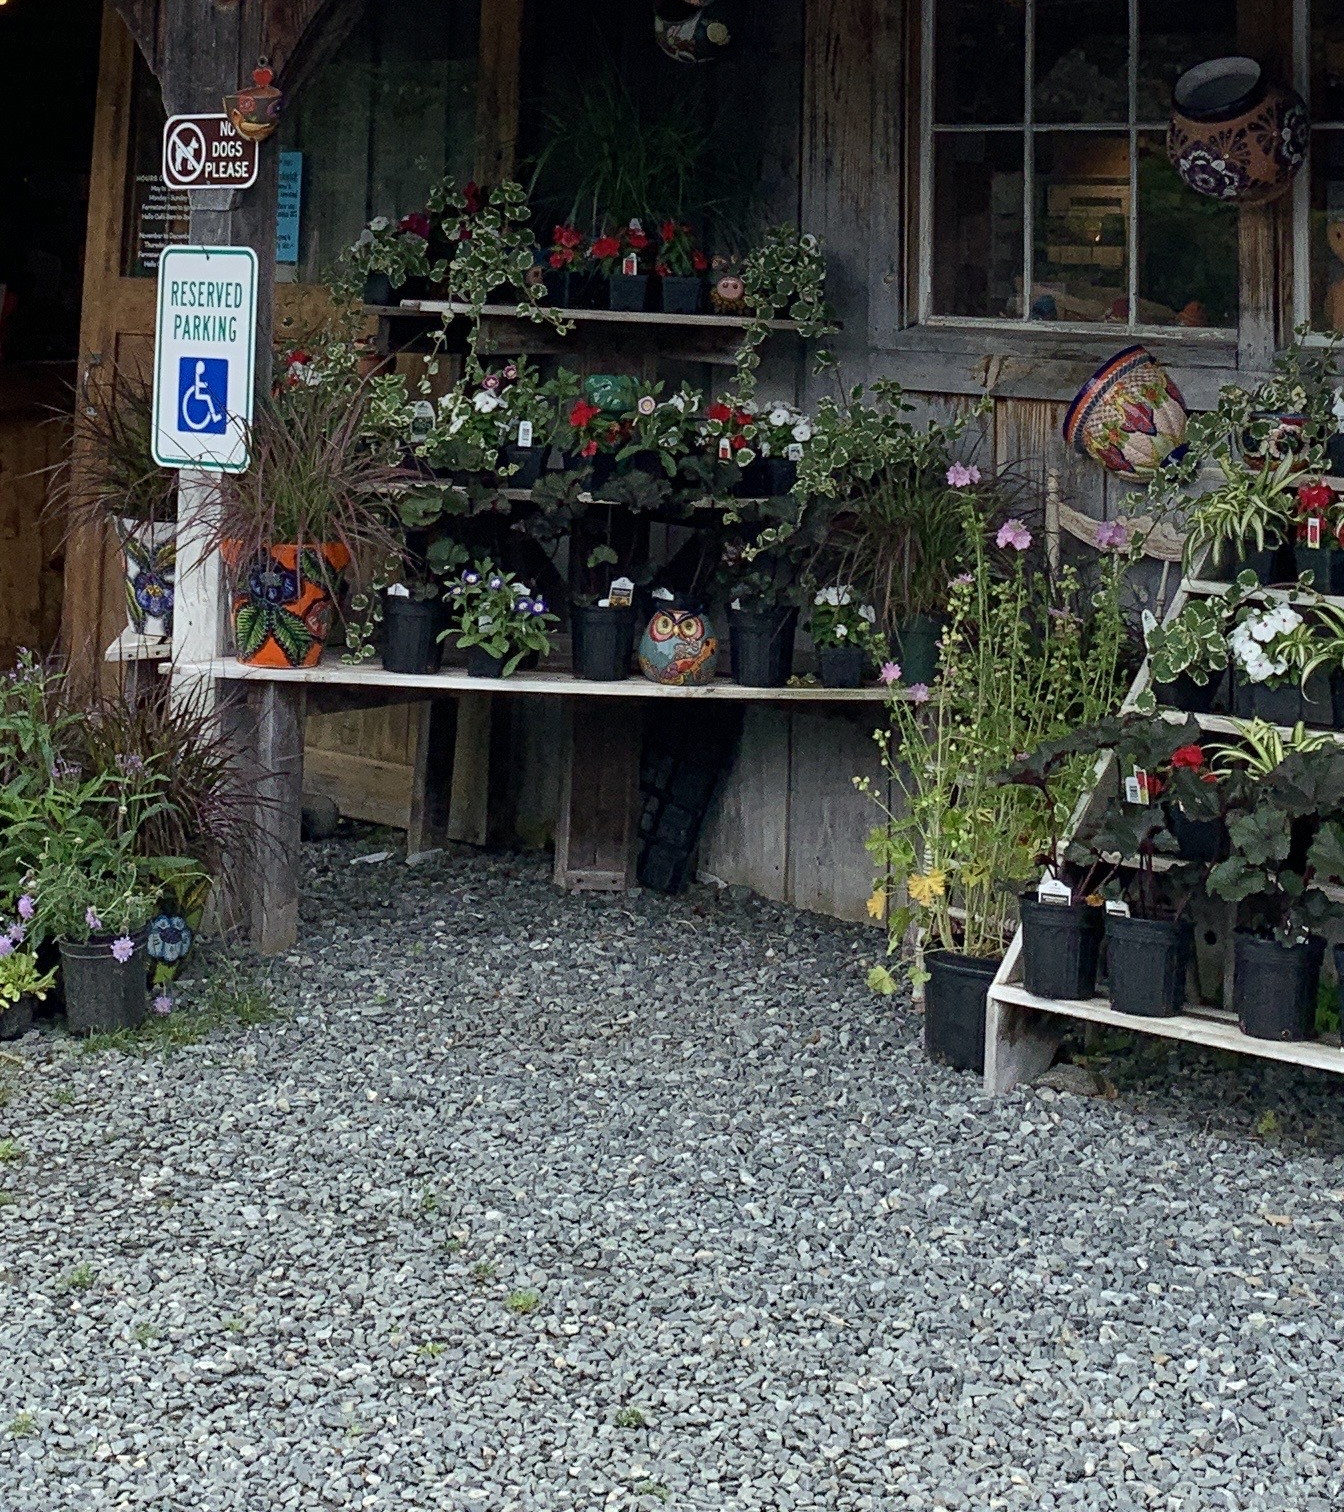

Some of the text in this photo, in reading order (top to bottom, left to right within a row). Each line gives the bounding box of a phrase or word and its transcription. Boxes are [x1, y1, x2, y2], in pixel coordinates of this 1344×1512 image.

[220, 120, 235, 137] NO
[212, 141, 243, 157] DOGS
[205, 161, 249, 178] PLEASE
[171, 281, 243, 308] RESERVED
[174, 314, 237, 342] PARKING
